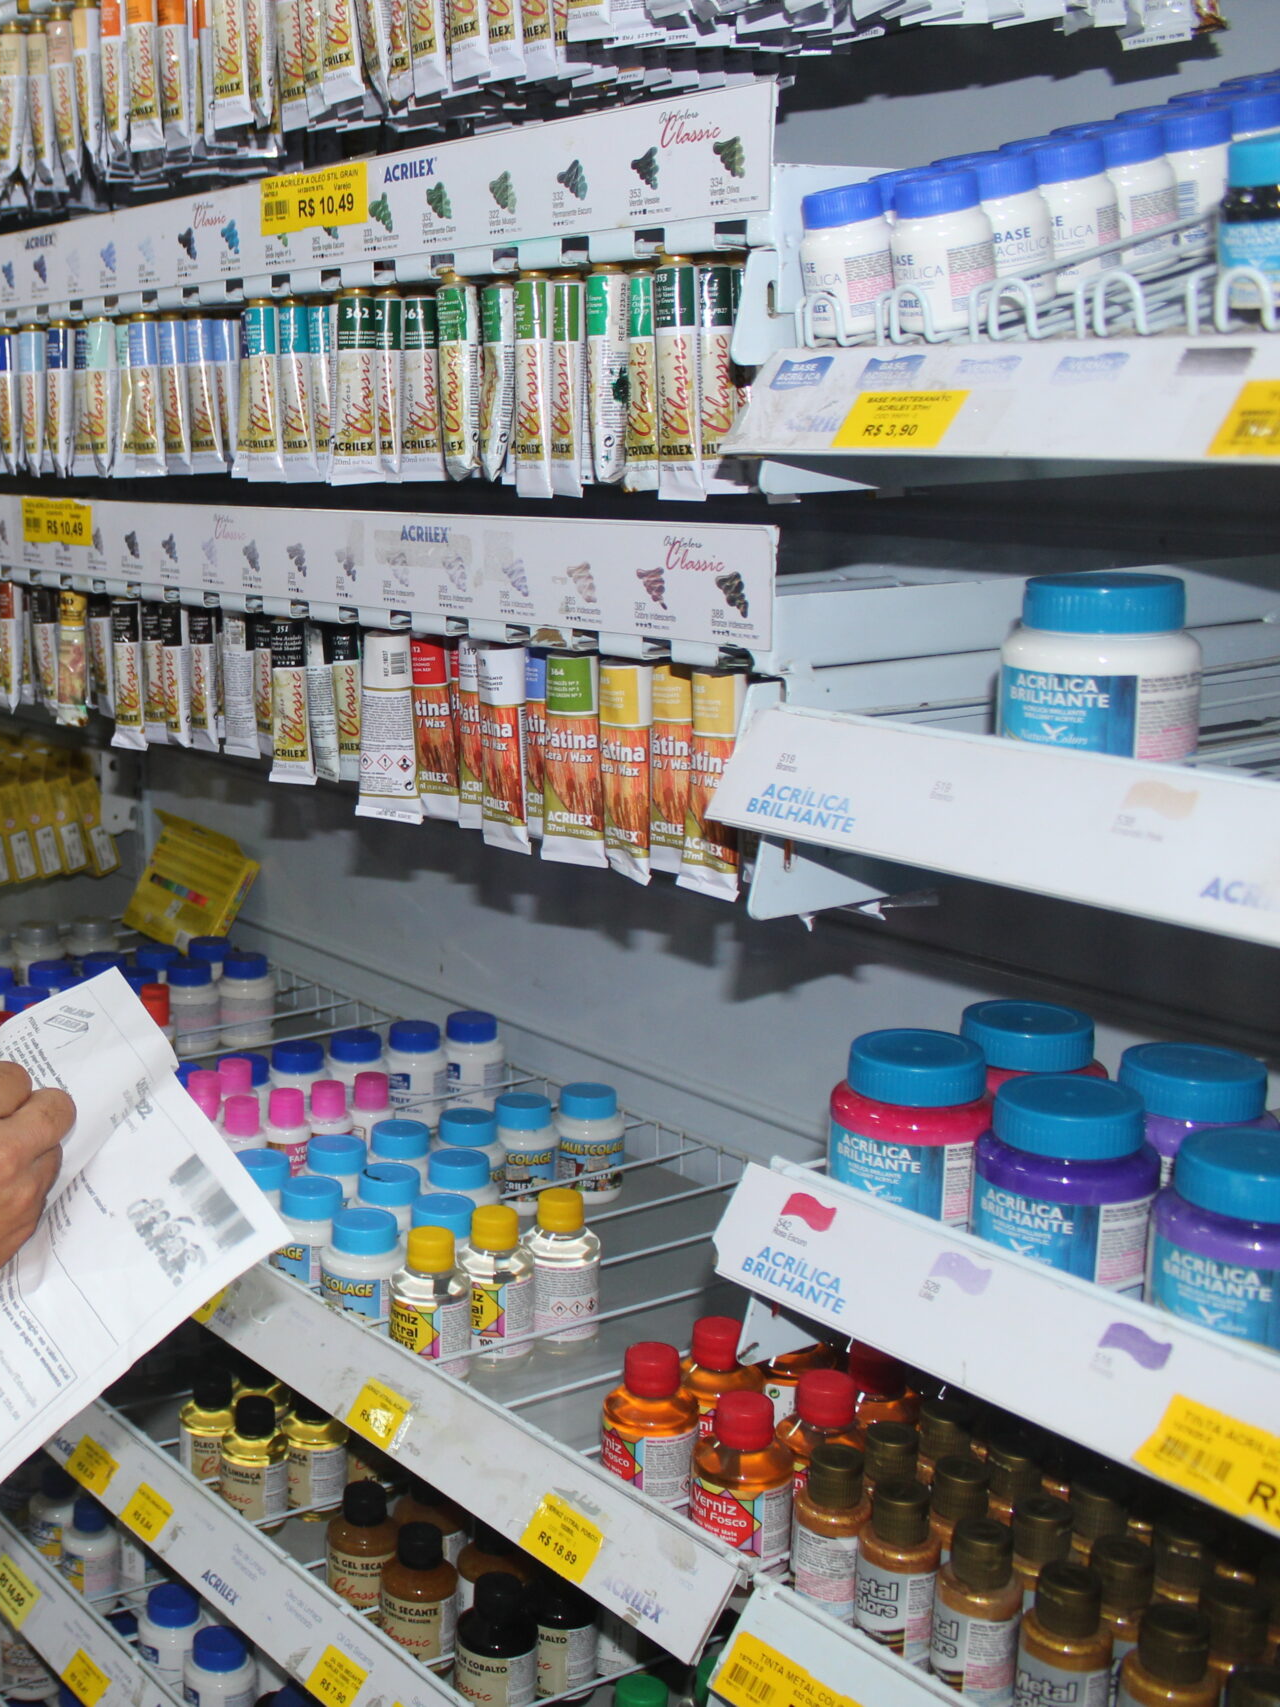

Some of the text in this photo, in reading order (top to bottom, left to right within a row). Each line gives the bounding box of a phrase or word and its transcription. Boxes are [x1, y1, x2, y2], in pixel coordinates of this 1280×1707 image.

[452, 20, 479, 38] CRILEX
[488, 23, 514, 38] RILEX
[324, 52, 351, 66] CRILEX
[214, 80, 241, 95] CRILEX
[660, 114, 721, 148] Classic
[384, 157, 435, 183] ACRILEX
[298, 193, 354, 218] R$ 10,49
[993, 226, 1032, 244] BASE
[346, 306, 369, 319] 362
[667, 336, 690, 436] Classic
[863, 424, 918, 438] R$ 3,90
[47, 520, 83, 536] R$ 10,49
[400, 525, 449, 543] ACRILEX
[665, 540, 725, 572] Classic
[1016, 674, 1099, 693] ACRÍLICA
[285, 672, 305, 743] Classic
[415, 700, 450, 716] tina
[1009, 686, 1110, 708] BRILHANTE
[425, 720, 446, 728] Wax
[482, 714, 513, 738] átina
[545, 728, 598, 750] Pátina
[601, 738, 645, 762] átina
[652, 735, 688, 756] átin
[570, 751, 593, 763] Wax
[761, 783, 851, 814] ACRÍLICA
[548, 811, 593, 826] ACRILEX
[745, 798, 856, 834] BRILHANTE
[836, 1143, 921, 1174] BRILHANTE
[842, 1133, 912, 1161] ACRÍLICA
[984, 1188, 1064, 1220] ACRÍLICA
[980, 1198, 1074, 1235] BRILHANTE
[756, 1246, 842, 1294] ACRÍLICA
[1170, 1250, 1261, 1286] ACRÍLICA
[741, 1257, 847, 1315] BRILHANTE
[1162, 1259, 1273, 1302] BRILHANTE
[694, 1487, 737, 1516] Verniz
[710, 1512, 747, 1528] Fosco
[537, 1531, 552, 1546] R$
[201, 1569, 239, 1606] ACRILEX
[858, 1578, 899, 1602] etal
[760, 1653, 785, 1676] TINTA
